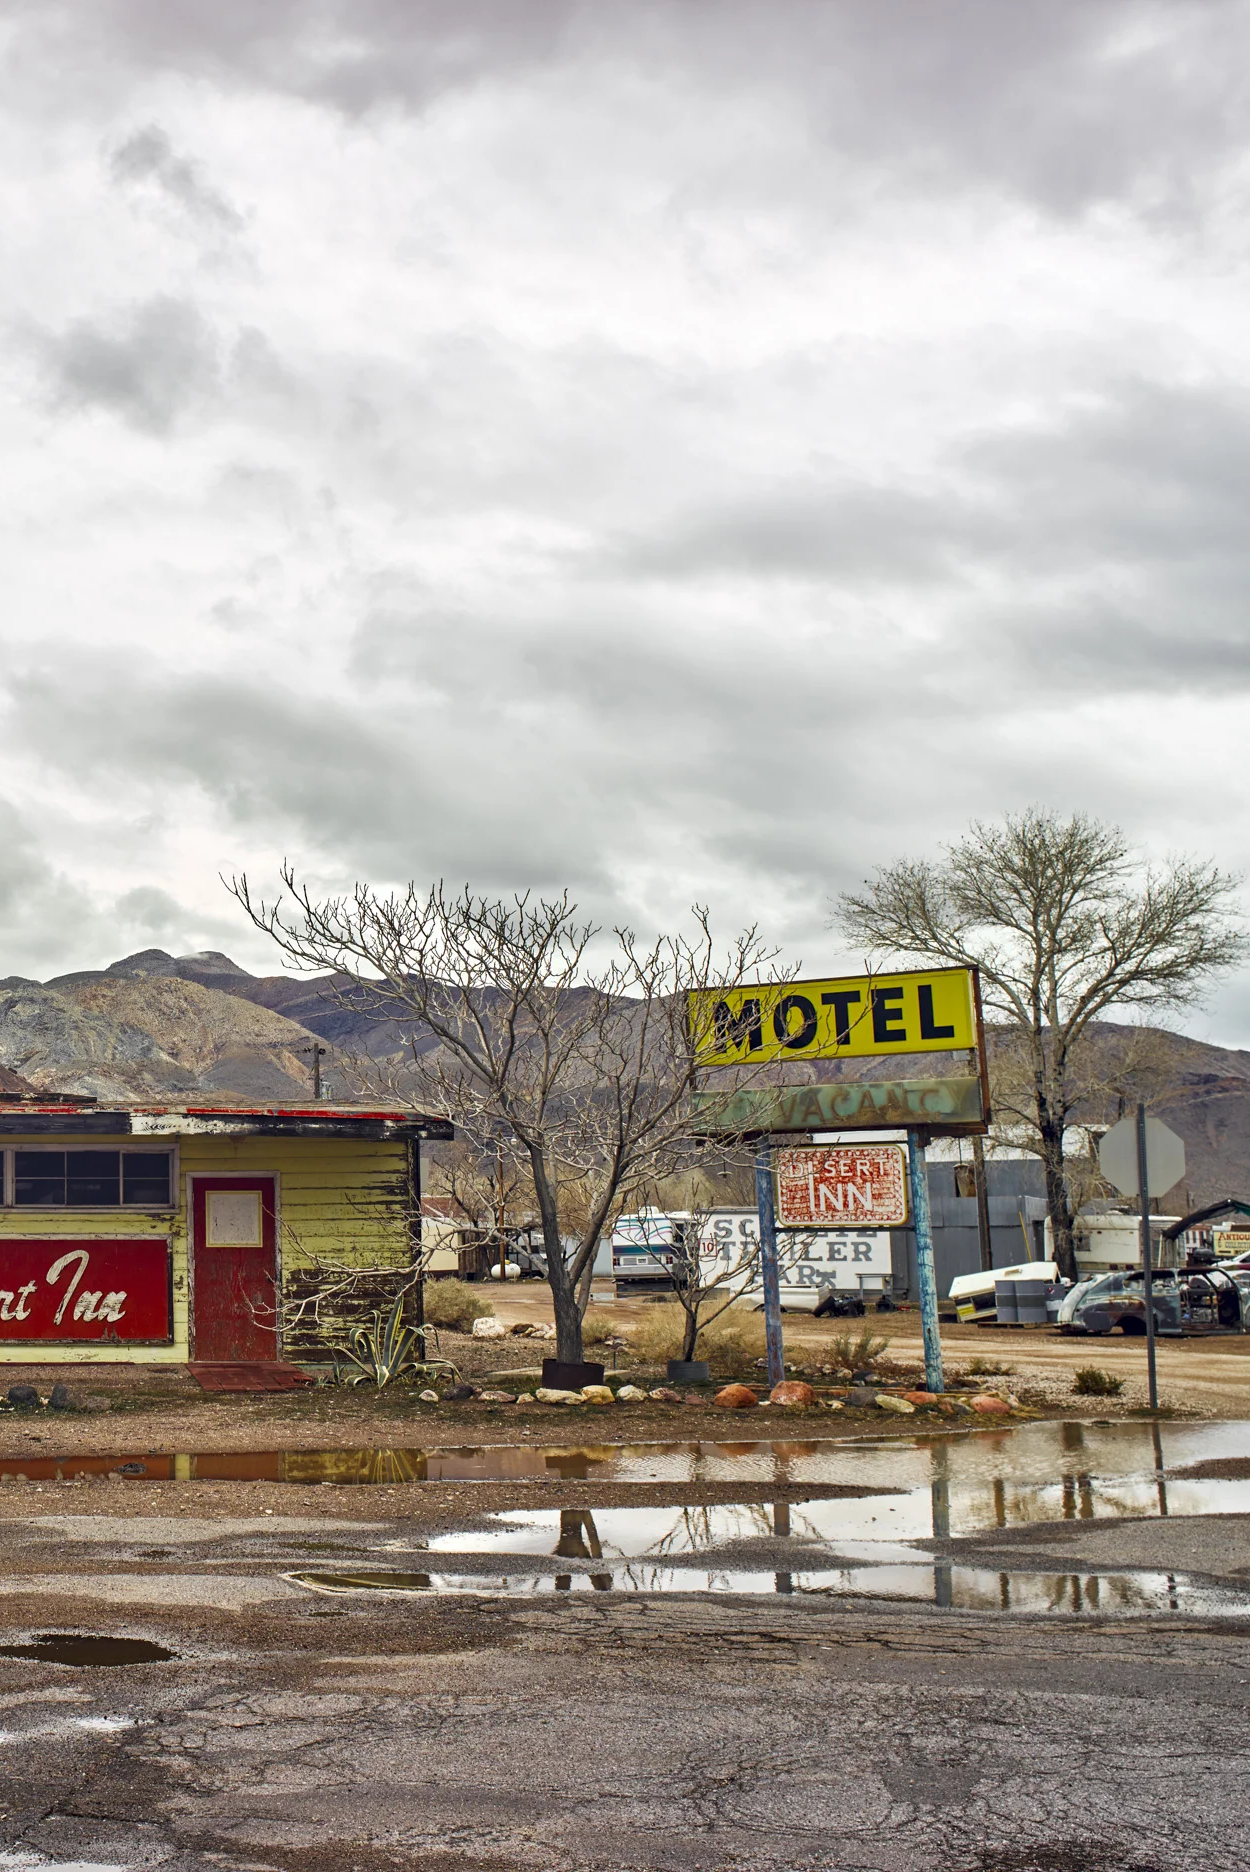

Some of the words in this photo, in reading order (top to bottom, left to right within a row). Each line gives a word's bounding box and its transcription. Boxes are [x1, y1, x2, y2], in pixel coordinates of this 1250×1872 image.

[712, 984, 955, 1054] MOTEL
[779, 1084, 969, 1124] VACANCY
[790, 1159, 887, 1177] DESERT
[809, 1179, 873, 1212] INN
[702, 1241, 715, 1253] 10
[718, 1241, 873, 1262] TRILER
[46, 1249, 127, 1326] Inn
